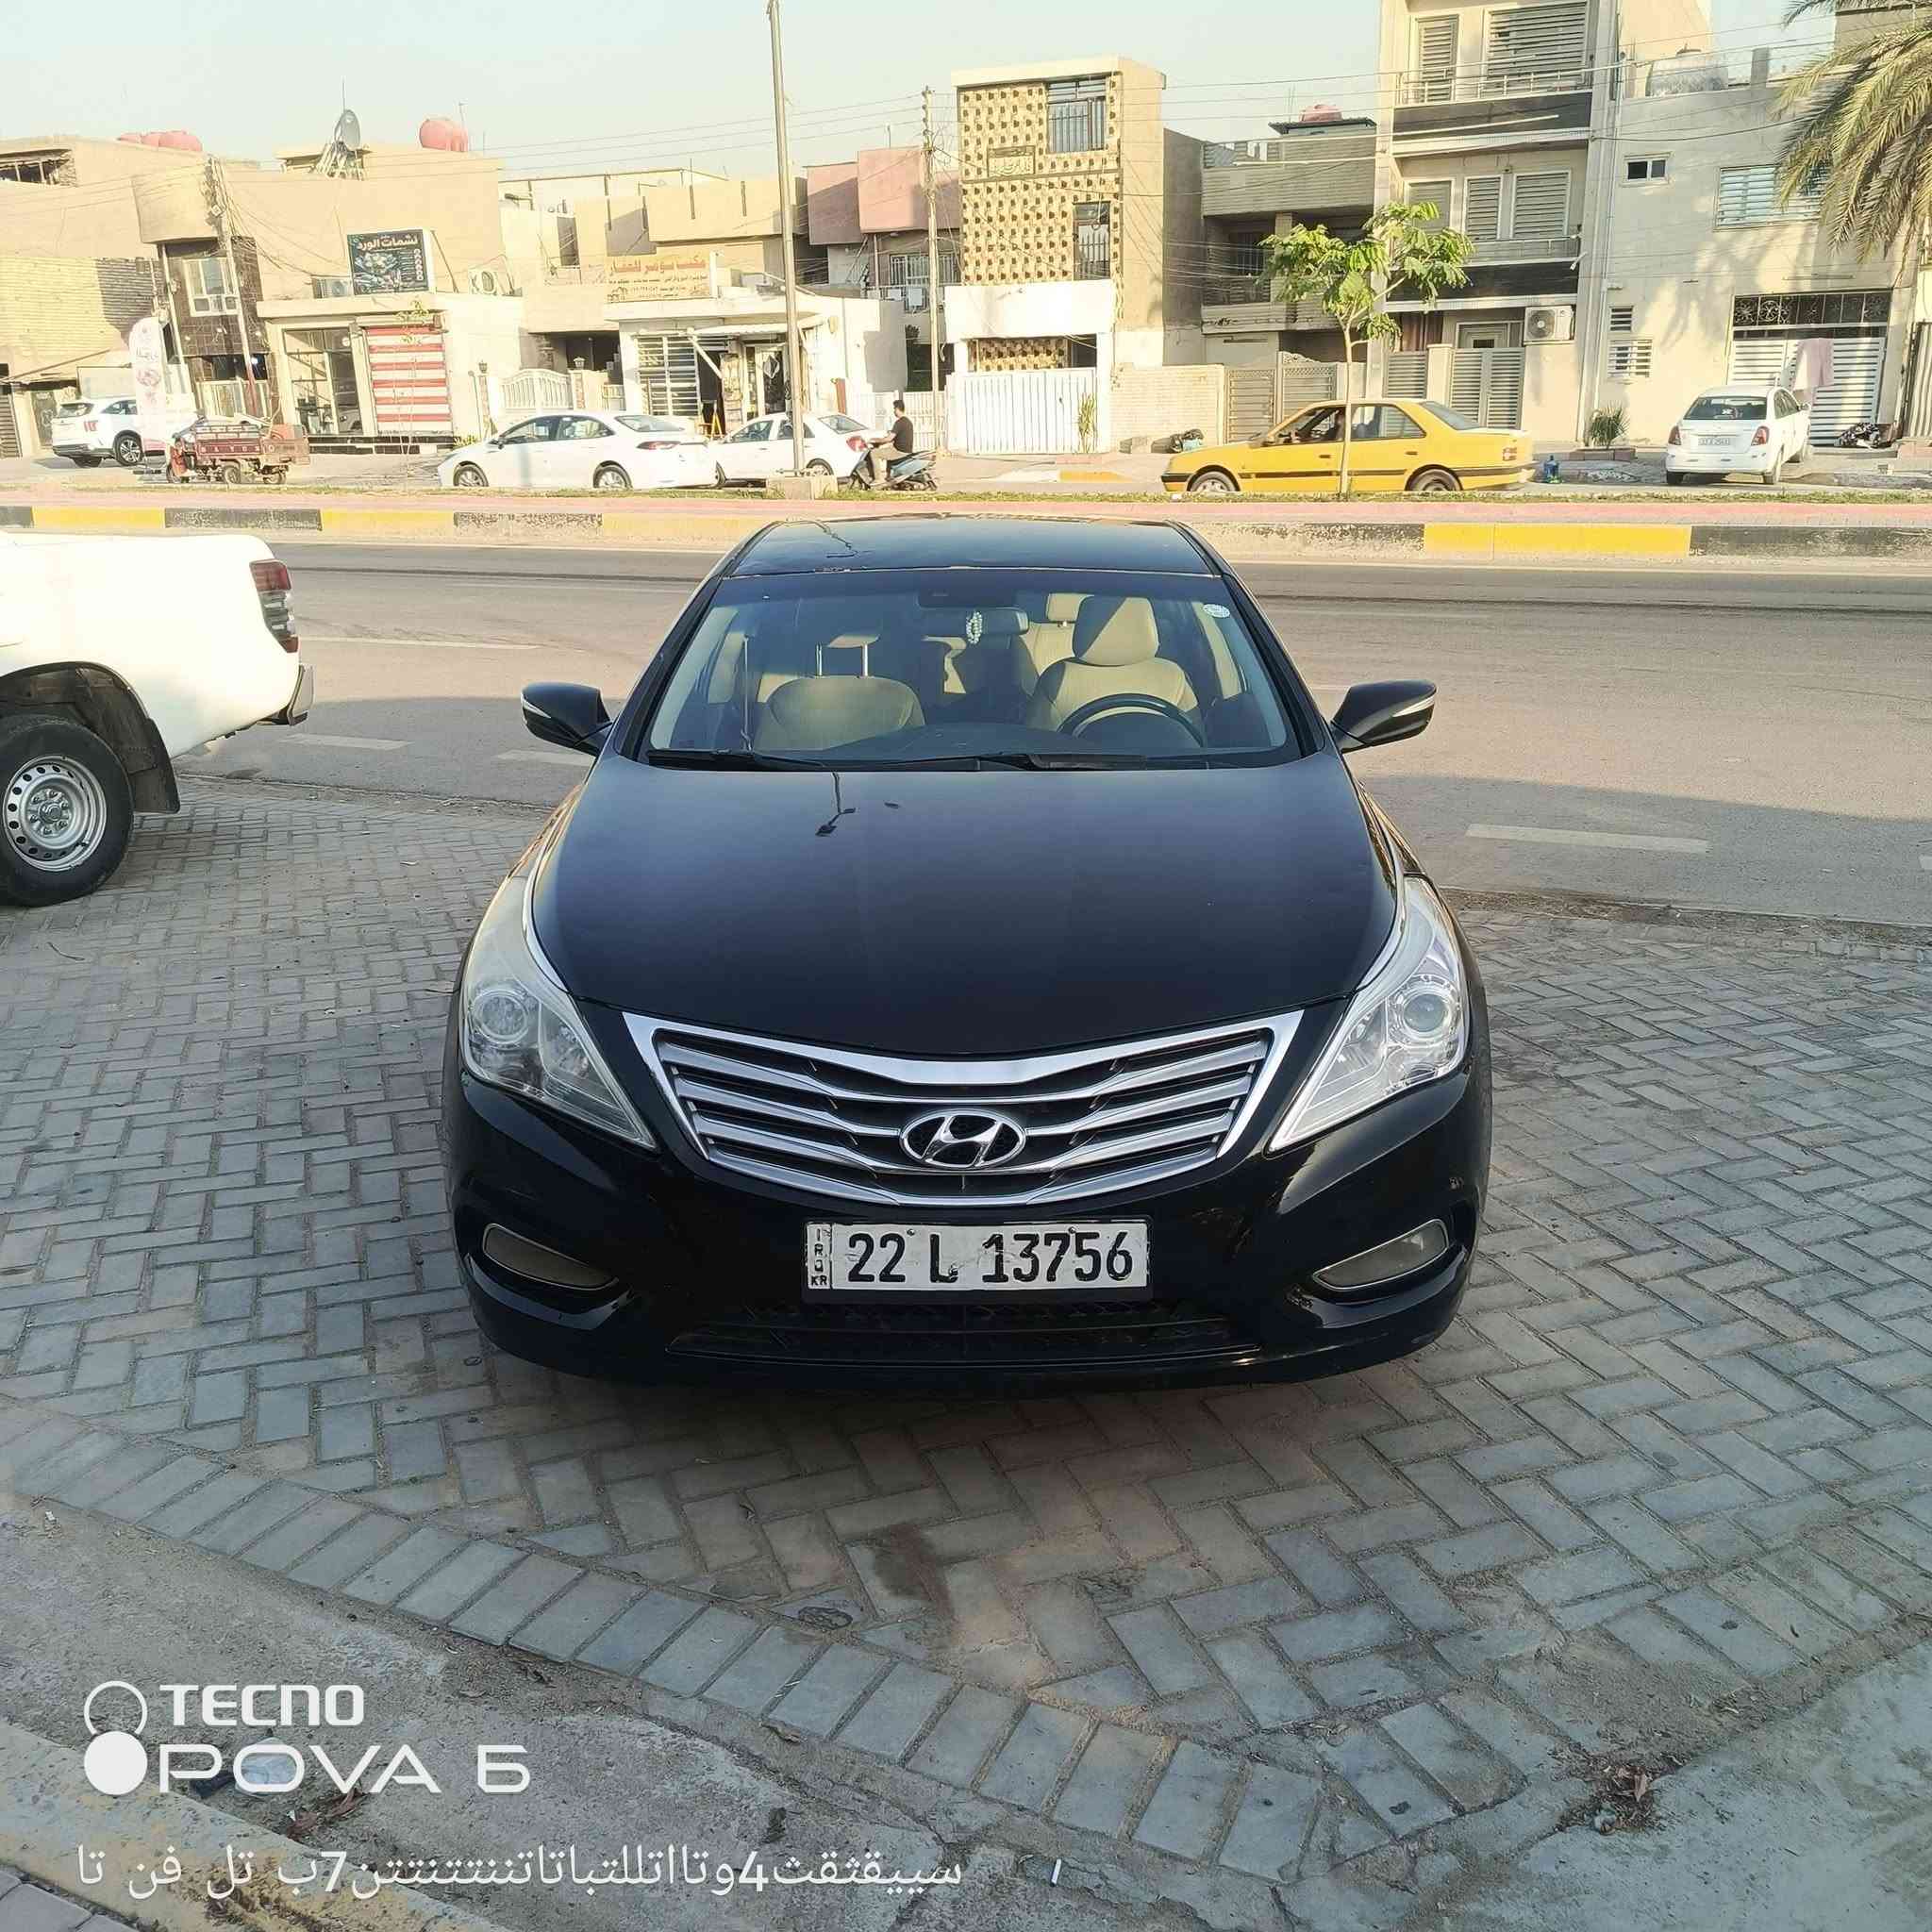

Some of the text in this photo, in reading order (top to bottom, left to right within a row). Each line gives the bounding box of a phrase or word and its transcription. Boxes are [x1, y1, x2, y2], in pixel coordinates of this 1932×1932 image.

[848, 1231, 1133, 1283] 22 L 13756
[811, 1274, 827, 1286] KR
